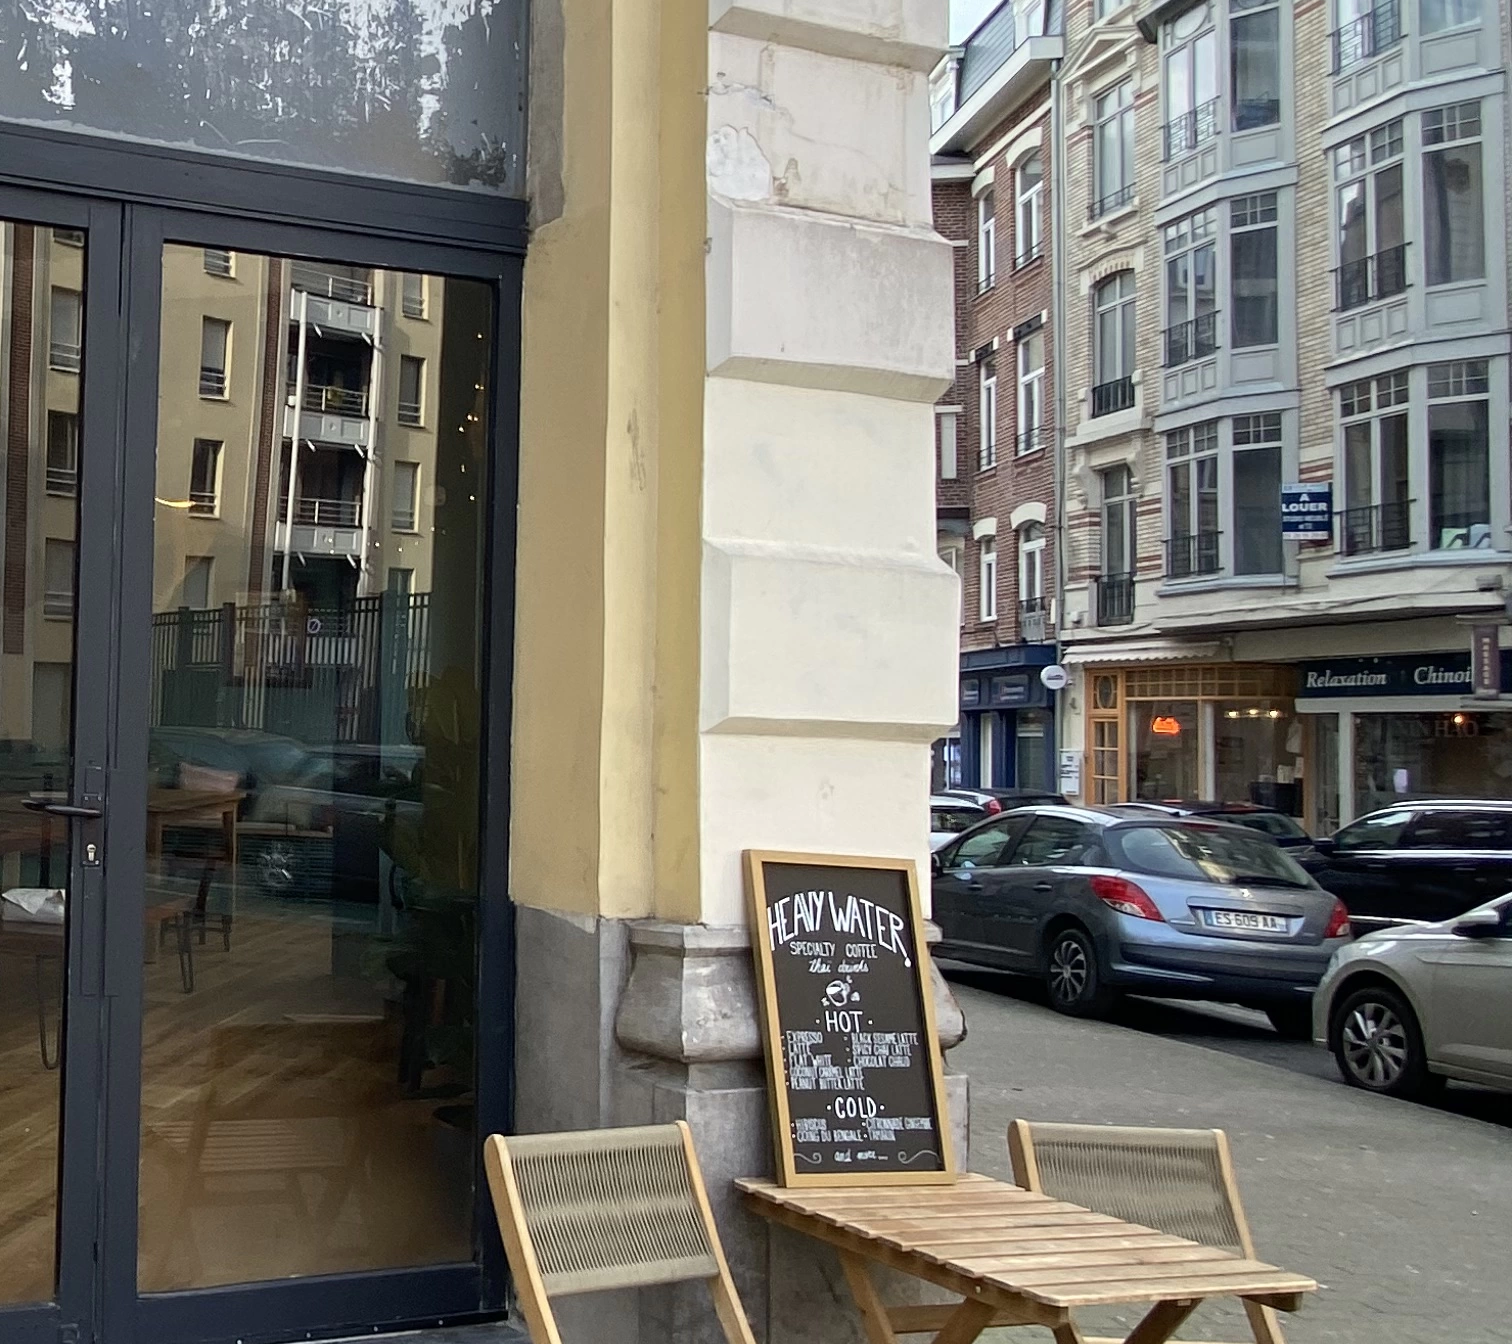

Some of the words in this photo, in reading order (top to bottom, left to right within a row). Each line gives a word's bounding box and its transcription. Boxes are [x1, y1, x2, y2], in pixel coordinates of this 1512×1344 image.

[1281, 502, 1328, 512] LOUER
[1307, 670, 1388, 688] Relaxation
[766, 891, 825, 951] HEAVY
[828, 891, 909, 961] WATER
[789, 941, 836, 957] SPECIALTY
[845, 943, 878, 959] COFFEE
[824, 1009, 864, 1034] HOT
[834, 1096, 877, 1119] COLD
